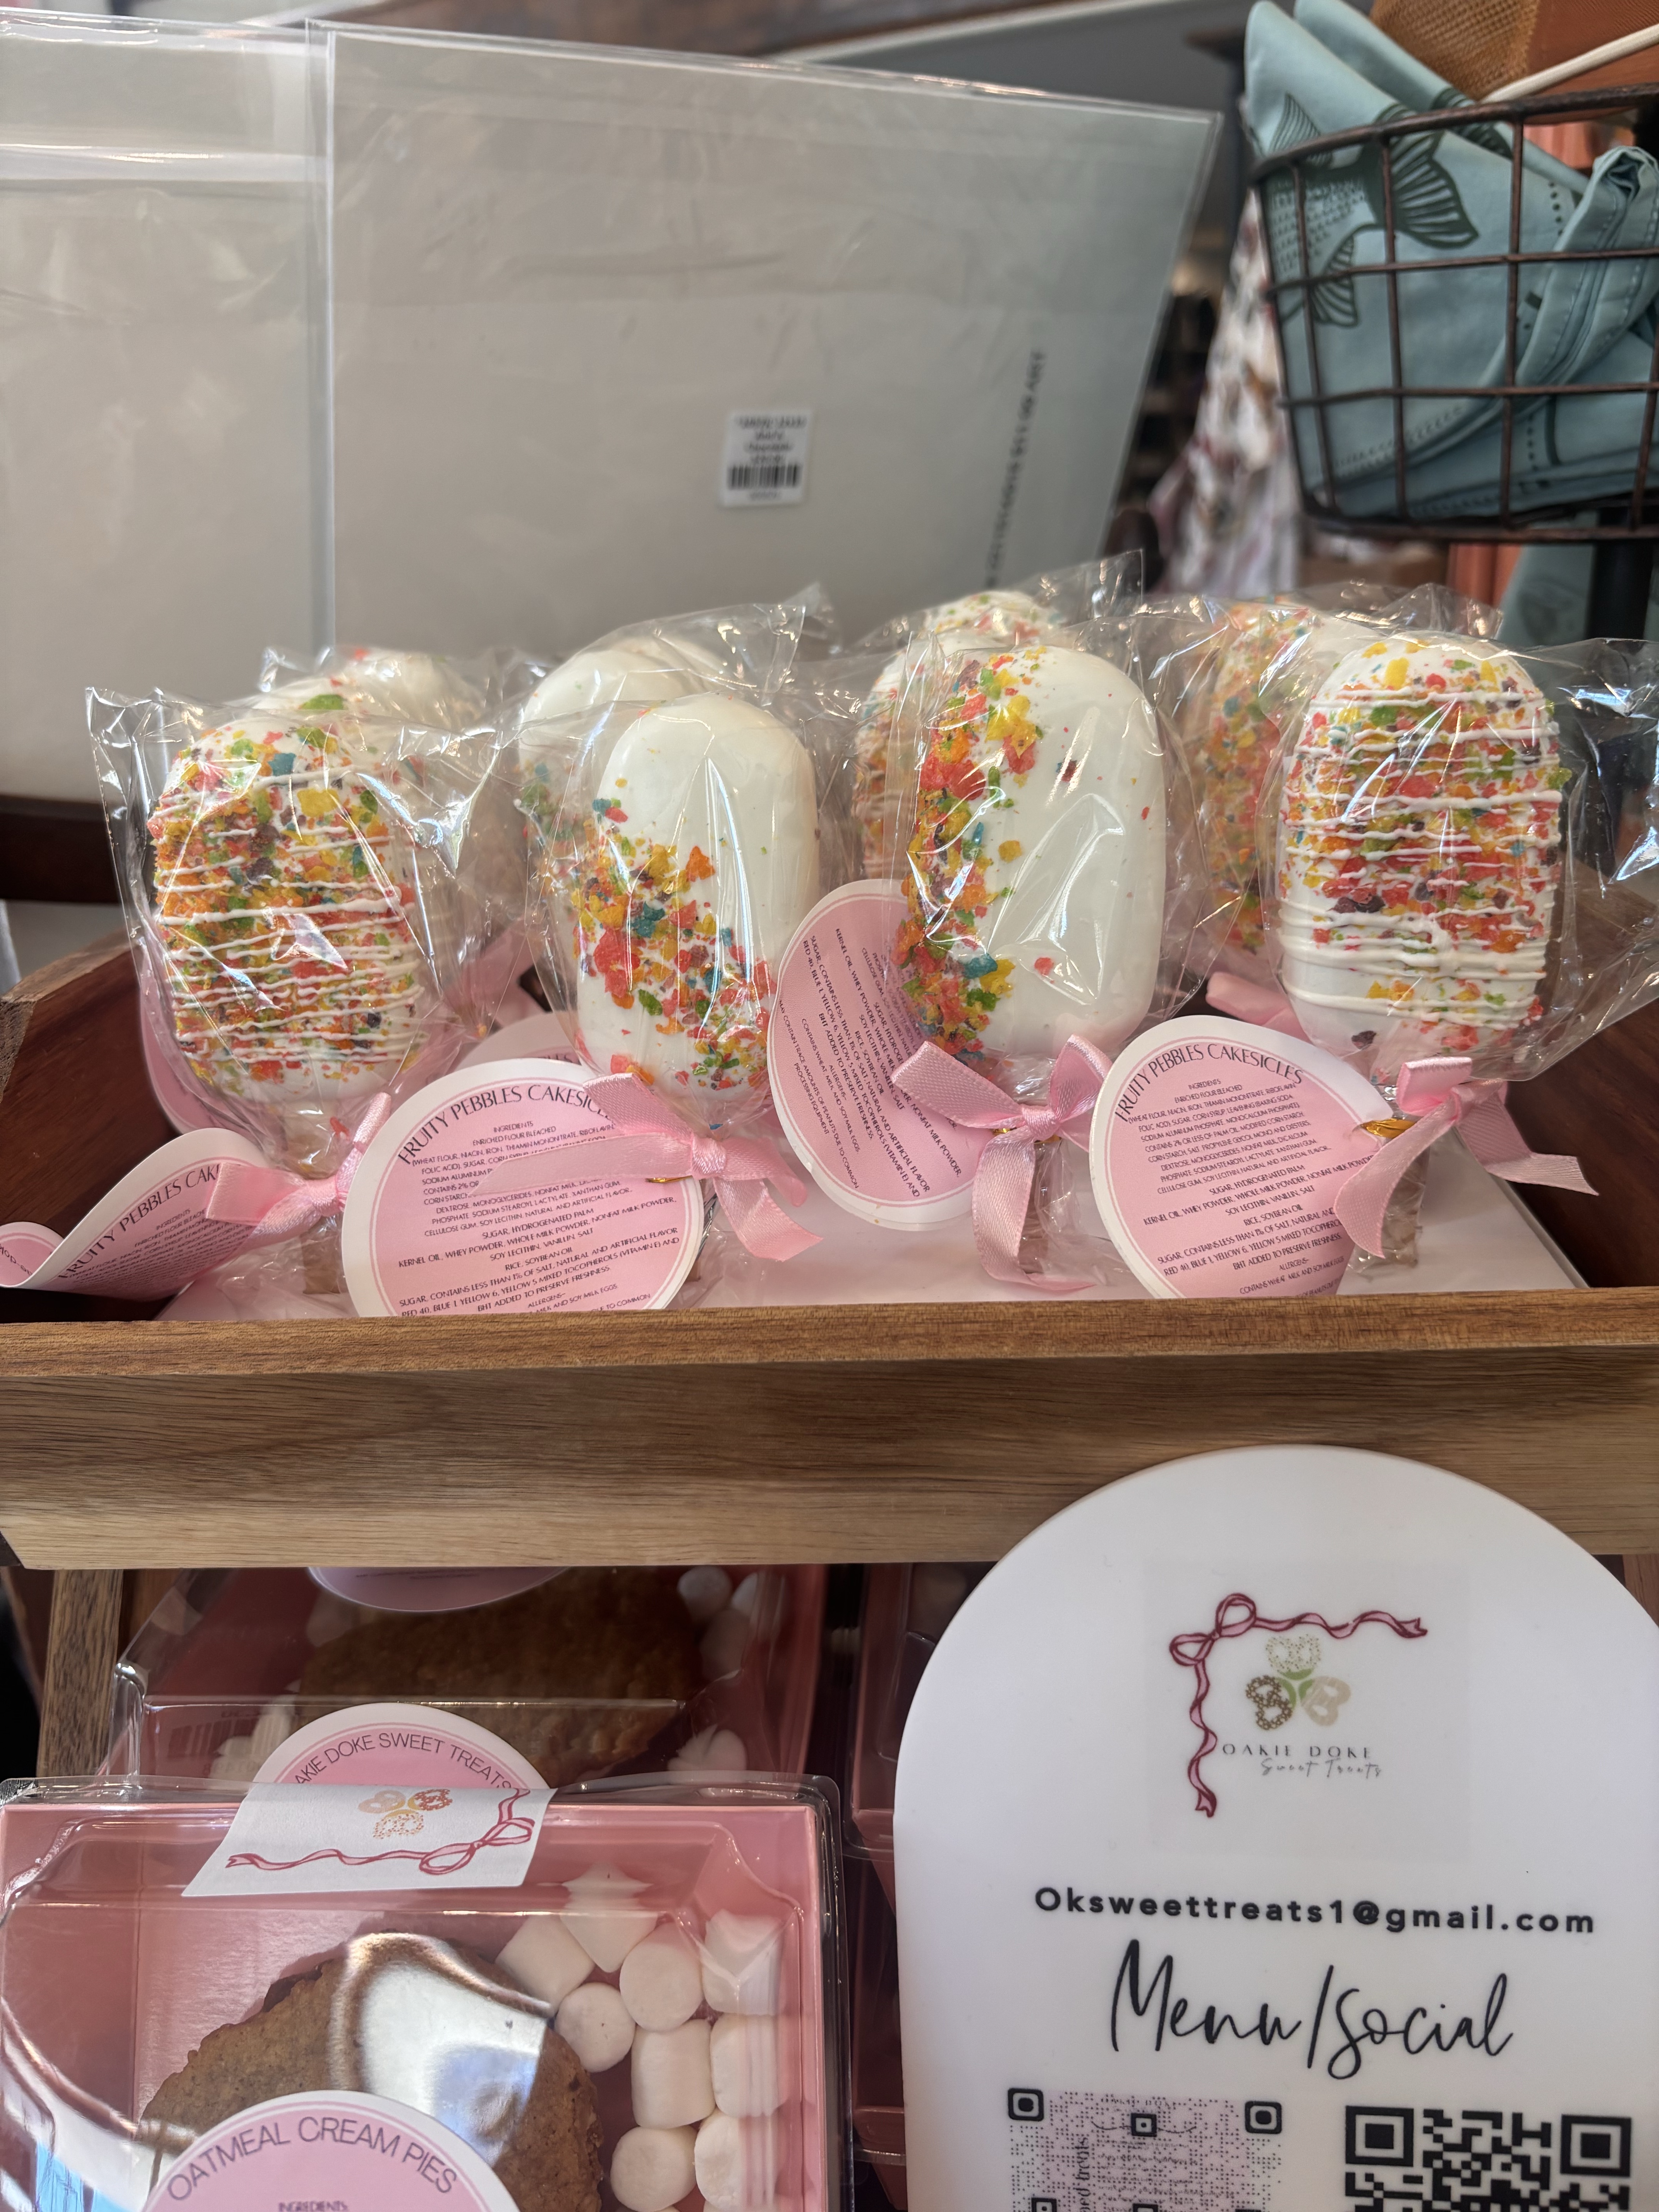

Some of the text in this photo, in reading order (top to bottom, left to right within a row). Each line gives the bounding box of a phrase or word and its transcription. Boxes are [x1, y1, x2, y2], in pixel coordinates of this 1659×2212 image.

[1115, 1044, 1304, 1121] FRUITY PEBBLES CAKESICLES
[397, 1114, 449, 1165] FRUITY
[452, 1086, 522, 1120] PEBBLES
[58, 1230, 115, 1278] FRUITY
[119, 1179, 182, 1232] PEBBLES
[295, 1757, 327, 1784] AKIE
[326, 1735, 375, 1762] DOKE
[378, 1733, 445, 1753] SWEET
[1223, 1744, 1370, 1759] OAKIE DOKE
[1034, 1887, 1594, 1934] Oksweettreats1@gmail.com
[168, 2117, 457, 2200] OATMEAL CREAM PIES
